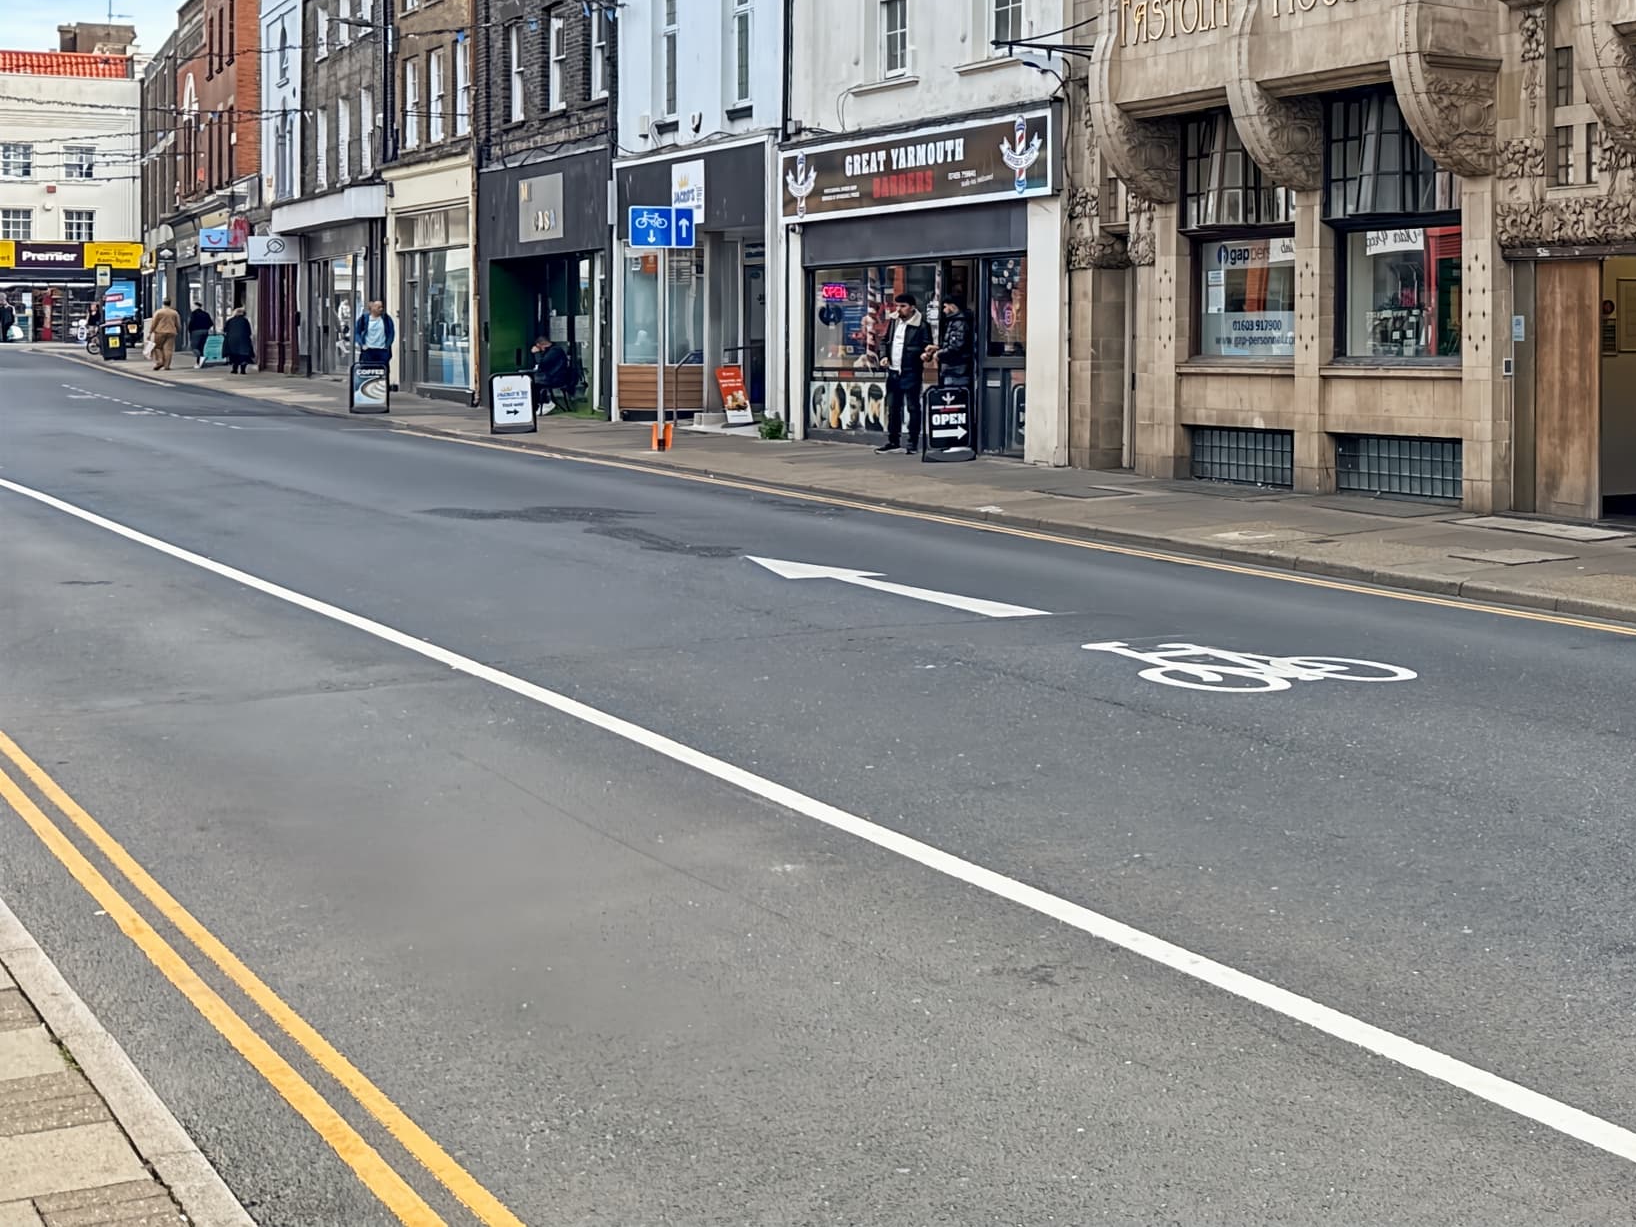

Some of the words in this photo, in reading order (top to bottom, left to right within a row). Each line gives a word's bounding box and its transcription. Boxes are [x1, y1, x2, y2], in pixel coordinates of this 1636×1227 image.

[844, 150, 886, 177] GREAT
[890, 138, 964, 170] YARMOUTH
[872, 170, 934, 198] BARBERS
[22, 251, 77, 262] Premier
[1230, 248, 1249, 265] gap
[1233, 320, 1254, 331] 01603
[932, 413, 967, 426] OPEN
